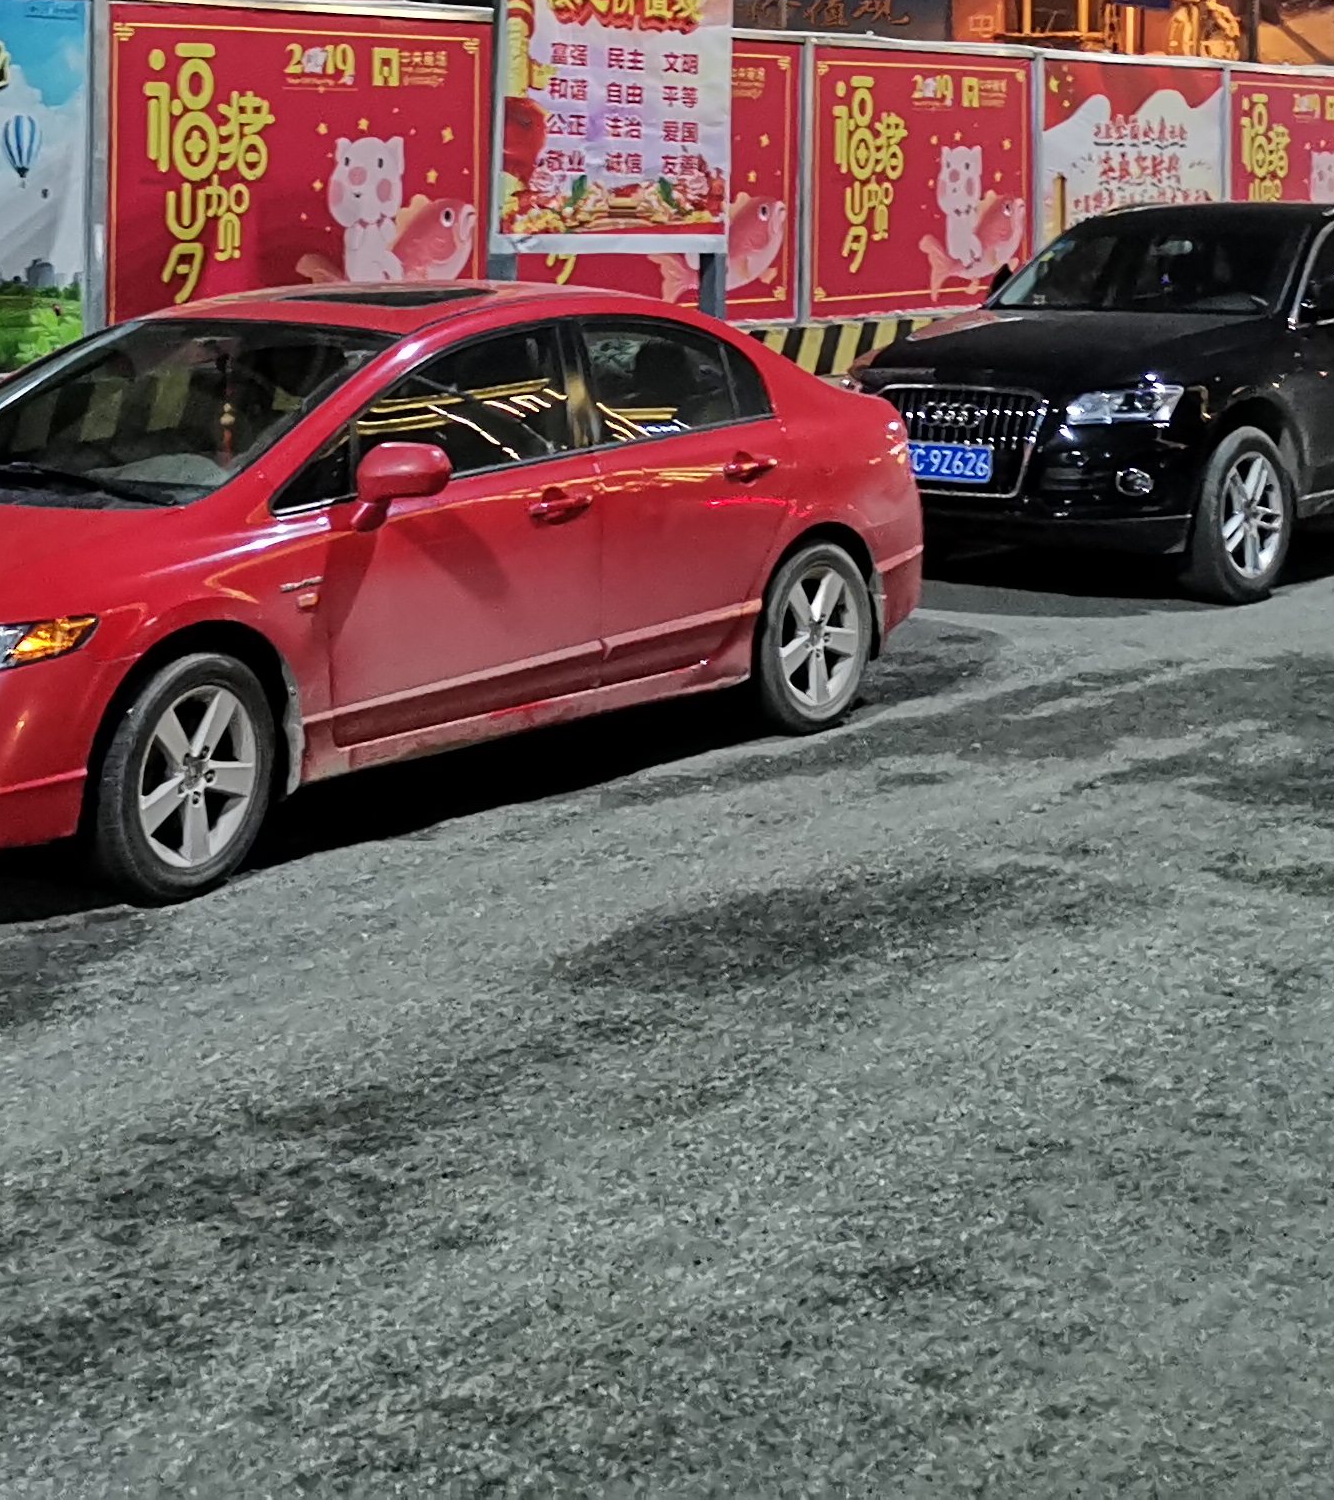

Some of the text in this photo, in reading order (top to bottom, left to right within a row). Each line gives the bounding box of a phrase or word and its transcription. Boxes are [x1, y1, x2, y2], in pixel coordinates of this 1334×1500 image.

[550, 41, 699, 75] 富强 民主 文明
[548, 76, 699, 109] 和谐 自由 平等
[546, 114, 699, 144] 公正 法治 爱国
[545, 150, 699, 178] 敬业 诚信 友善
